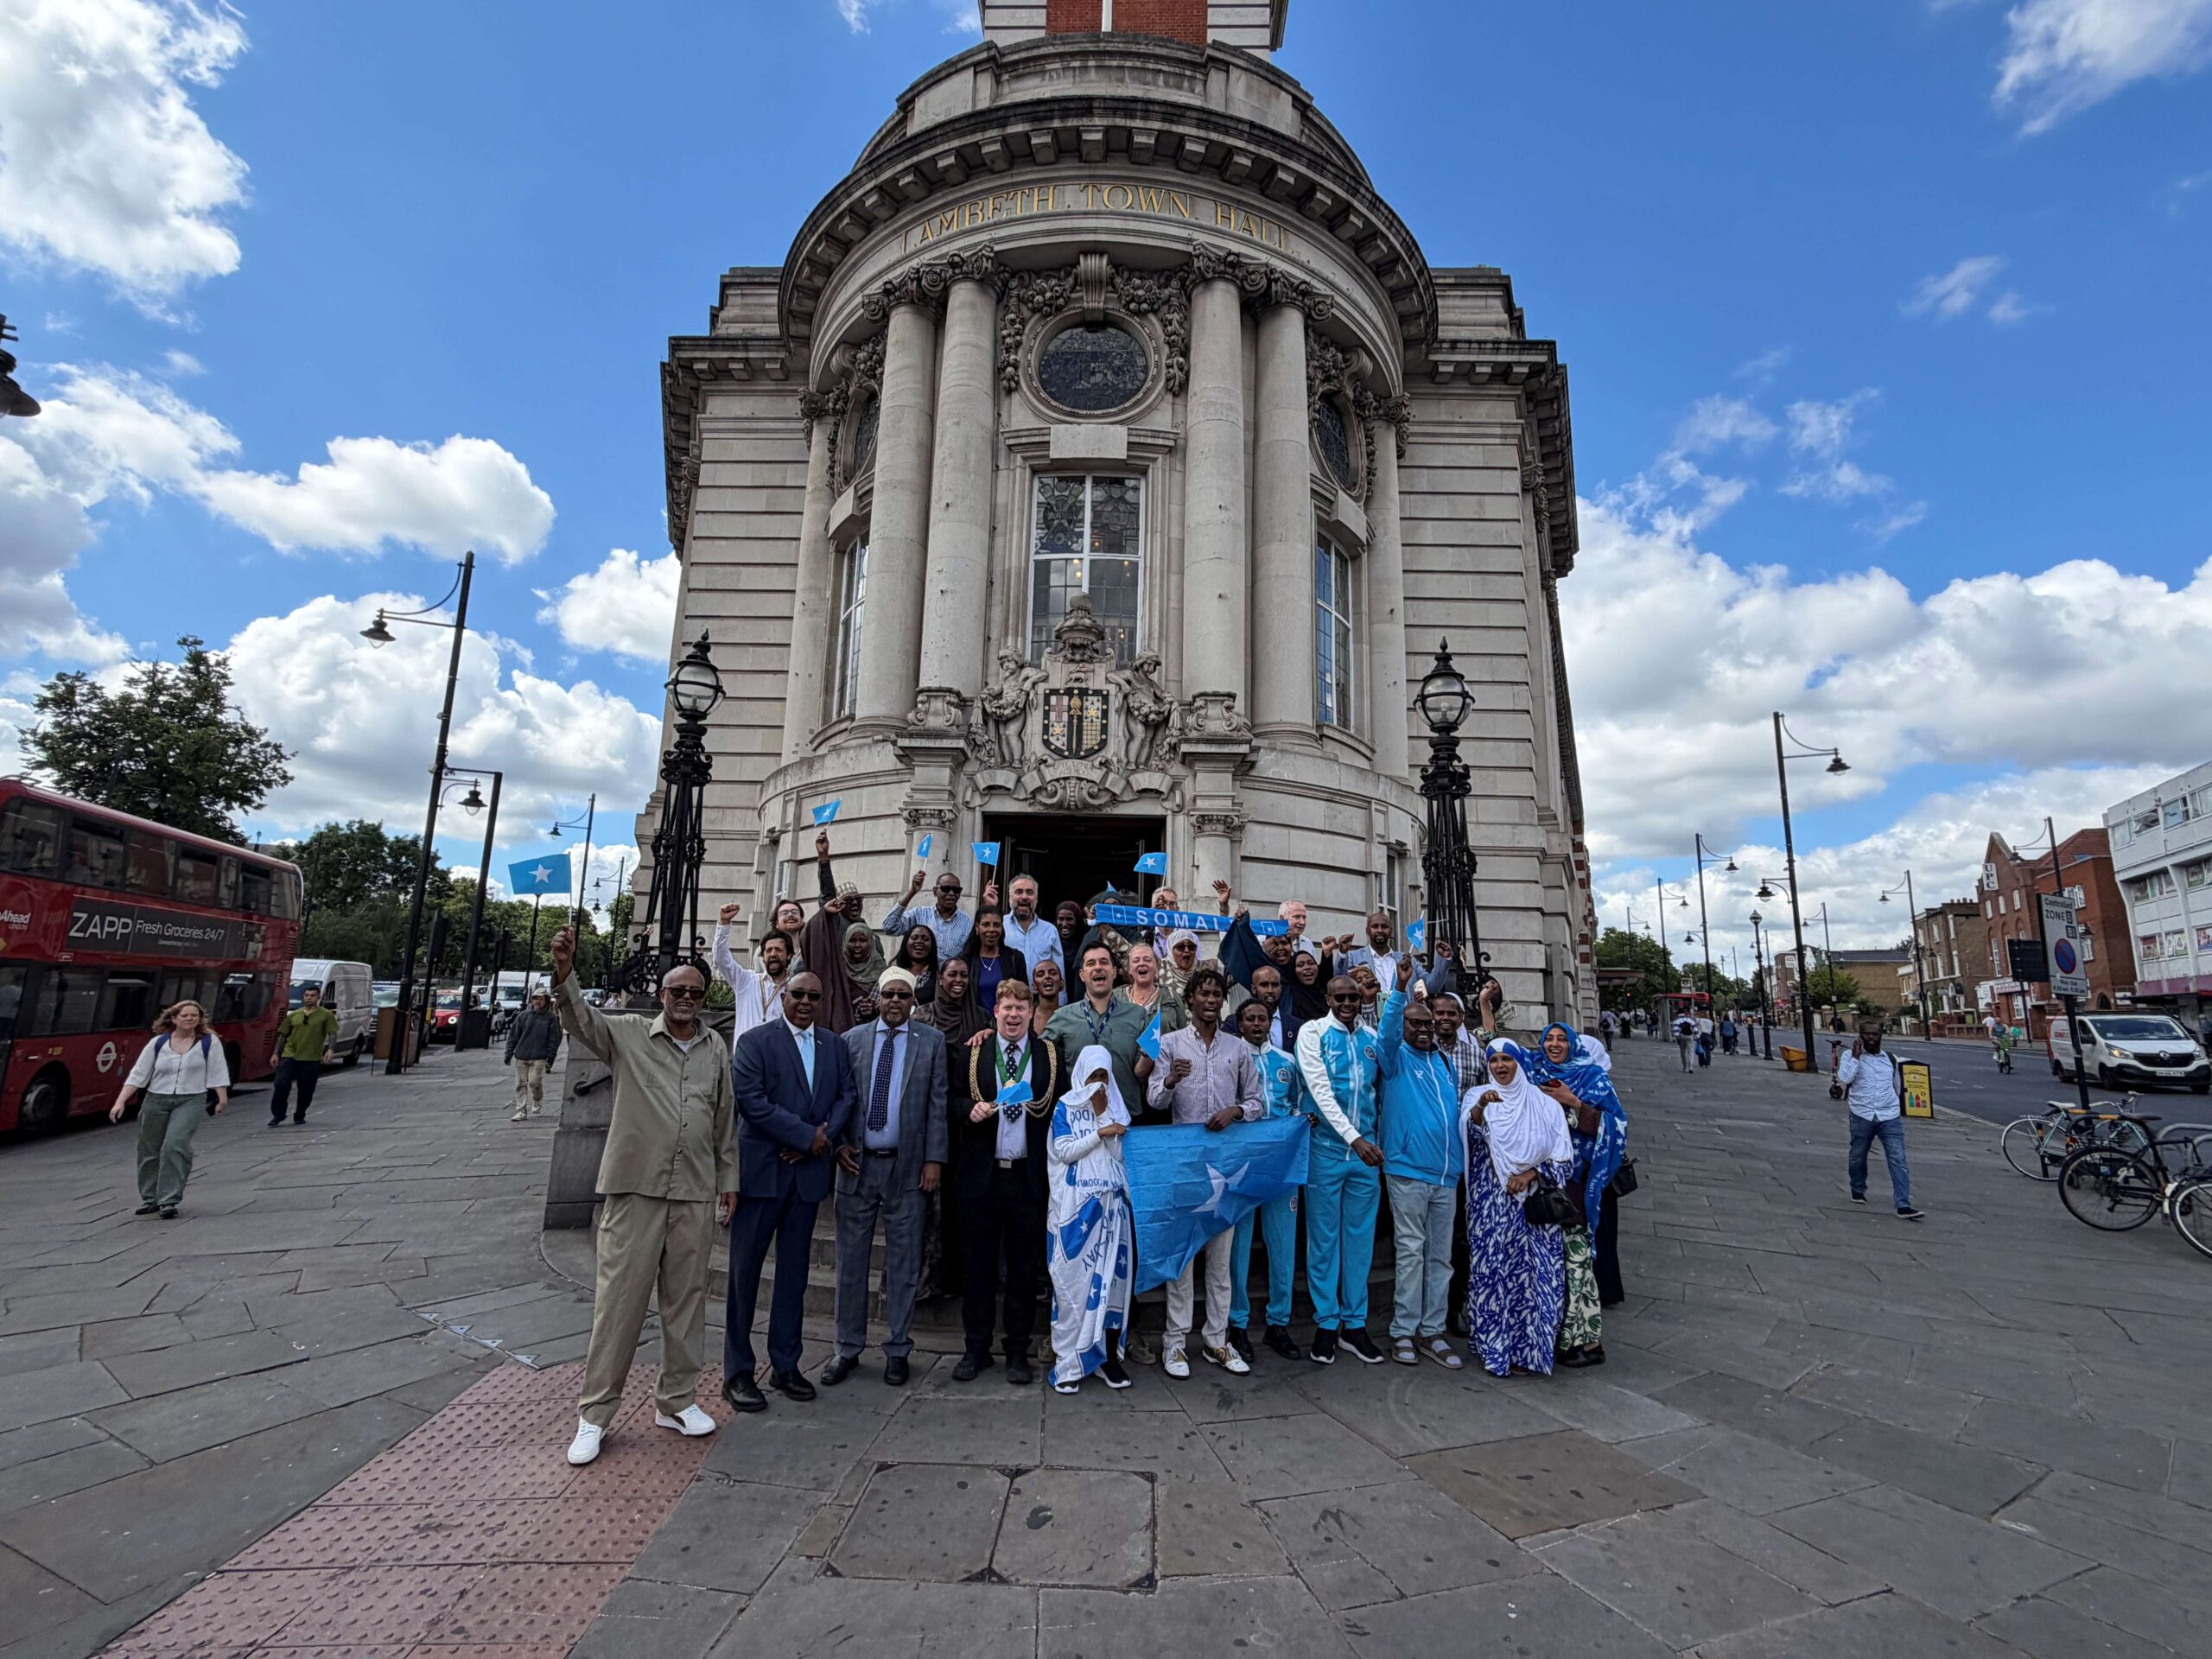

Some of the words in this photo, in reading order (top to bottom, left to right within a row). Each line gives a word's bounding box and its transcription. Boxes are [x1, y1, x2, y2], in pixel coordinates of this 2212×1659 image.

[1080, 182, 1191, 218] TOWN
[1985, 864, 1996, 889] UPC
[2044, 897, 2073, 909] Controlled
[0, 909, 31, 924] Ahead
[69, 912, 132, 940] ZAPP
[136, 919, 162, 936] Fresh
[164, 923, 204, 939] Groceries
[204, 927, 225, 941] 24/7
[1136, 910, 1234, 931] SOMAL
[2044, 910, 2066, 922] ZONE
